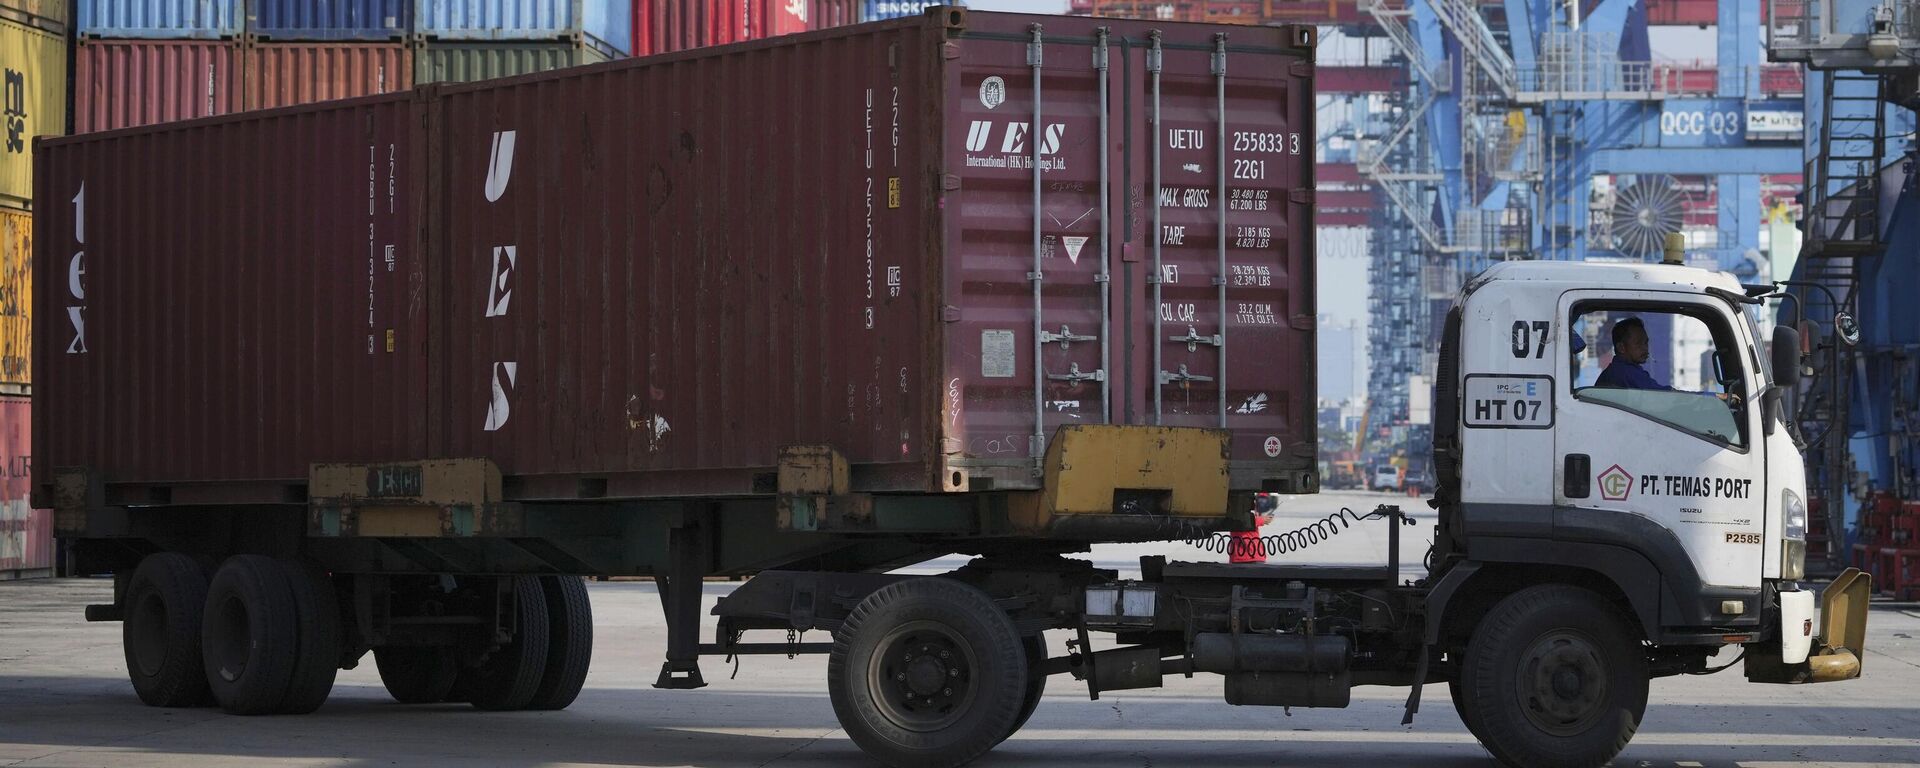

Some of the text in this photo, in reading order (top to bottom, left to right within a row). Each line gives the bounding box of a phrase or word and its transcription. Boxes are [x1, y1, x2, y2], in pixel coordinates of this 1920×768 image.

[877, 2, 941, 14] SINOK
[1660, 111, 1738, 136] QCC 03
[966, 120, 1065, 155] UES
[1169, 129, 1299, 153] UETU 255833 3
[966, 154, 1066, 173] International (HK) Hoings Ltd.
[1233, 159, 1265, 180] 22G1
[1160, 188, 1209, 208] MAX. GROSS
[1231, 189, 1268, 199] 30.480 KGS
[1230, 199, 1267, 211] 67.200 LBS
[1163, 226, 1185, 245] TARE
[1237, 227, 1271, 238] 2.185 KGS
[1236, 238, 1270, 248] 4.820 LBS
[1161, 264, 1178, 283] NET
[1258, 266, 1270, 276] KGS
[1258, 276, 1271, 286] LBS
[890, 286, 900, 297] 87
[1238, 303, 1253, 314] 33.2
[1236, 314, 1255, 324] 1.173
[1512, 320, 1550, 359] 07
[1526, 381, 1537, 396] E
[1474, 399, 1542, 421] HT 07
[1640, 475, 1751, 499] PT. TEMAS PORT
[1726, 533, 1760, 544] P2585
